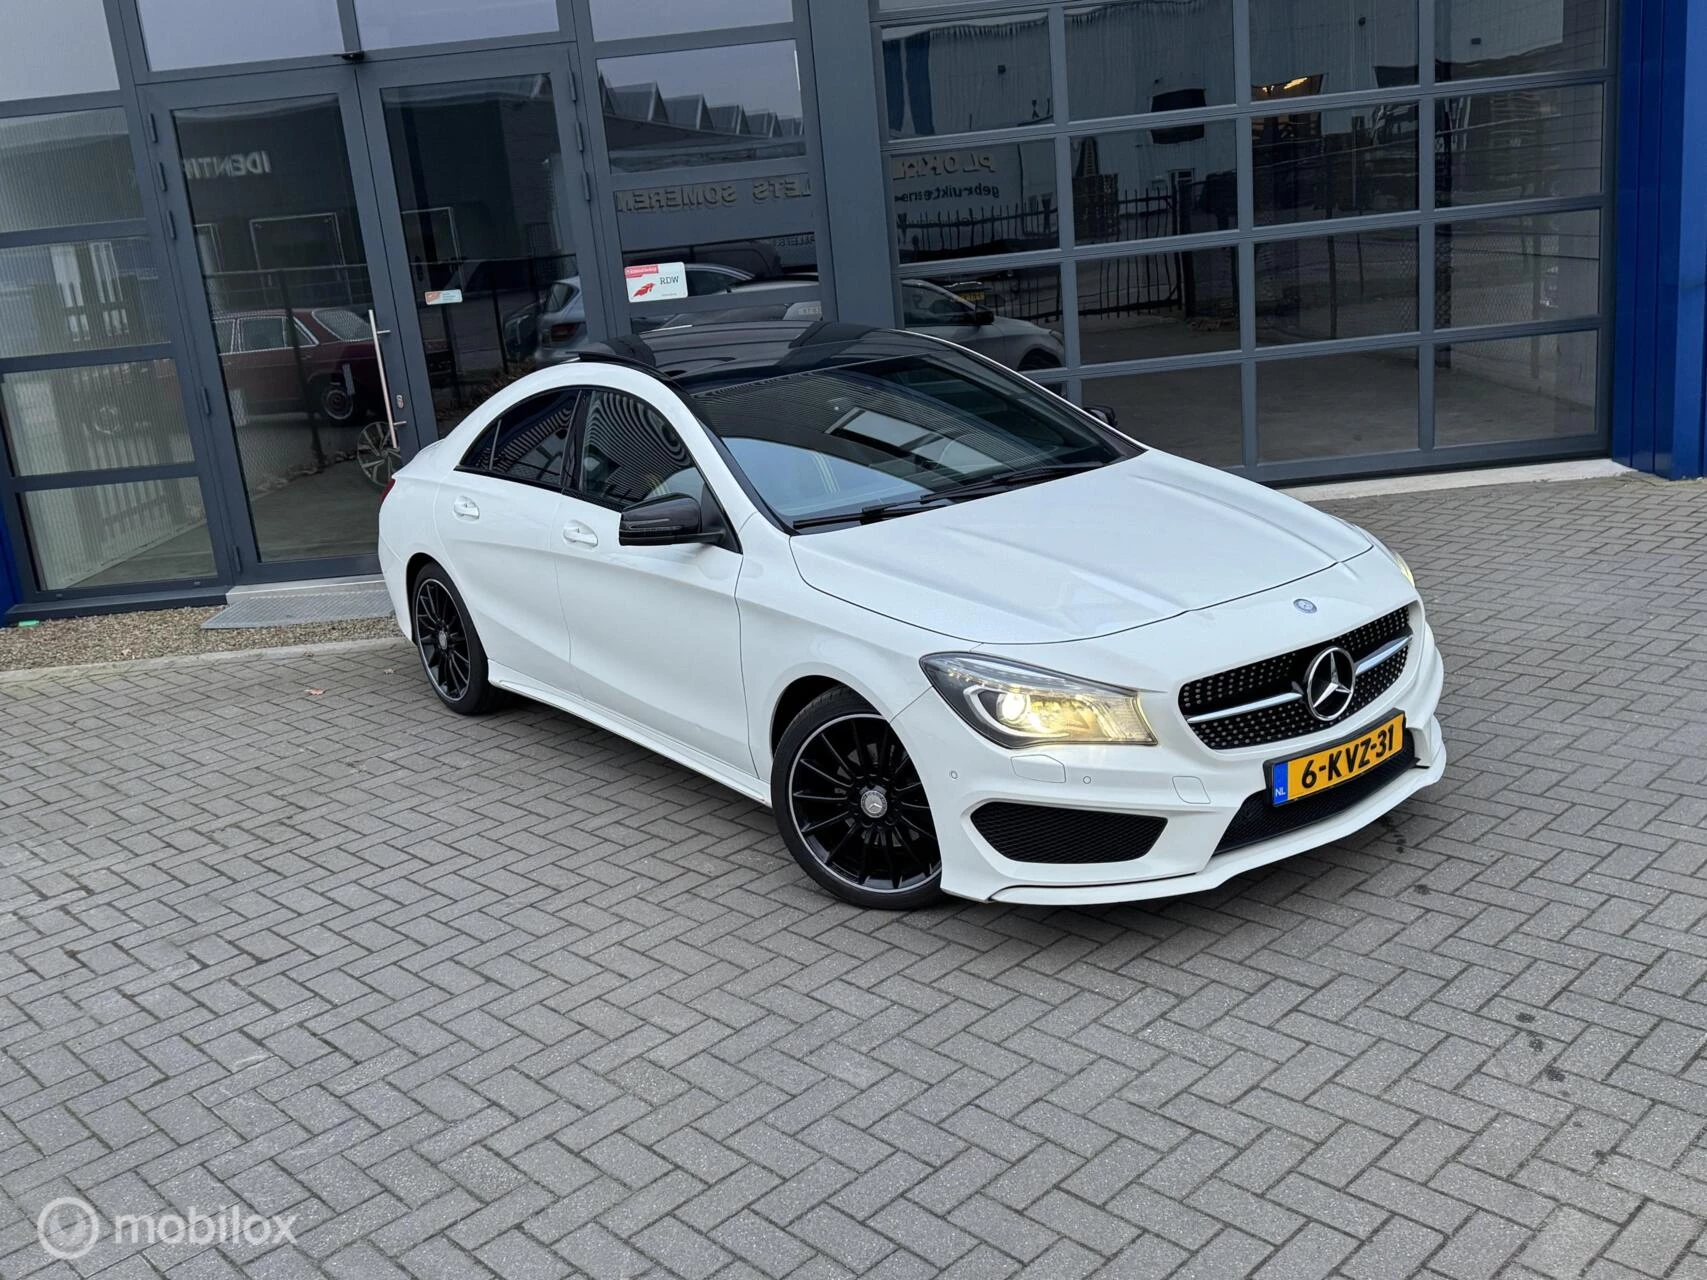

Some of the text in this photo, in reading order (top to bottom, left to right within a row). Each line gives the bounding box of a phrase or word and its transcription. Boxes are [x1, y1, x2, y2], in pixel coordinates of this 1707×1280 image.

[659, 275, 680, 286] RDW
[1301, 724, 1395, 789] 6-KVZ-31
[1275, 786, 1287, 797] NL
